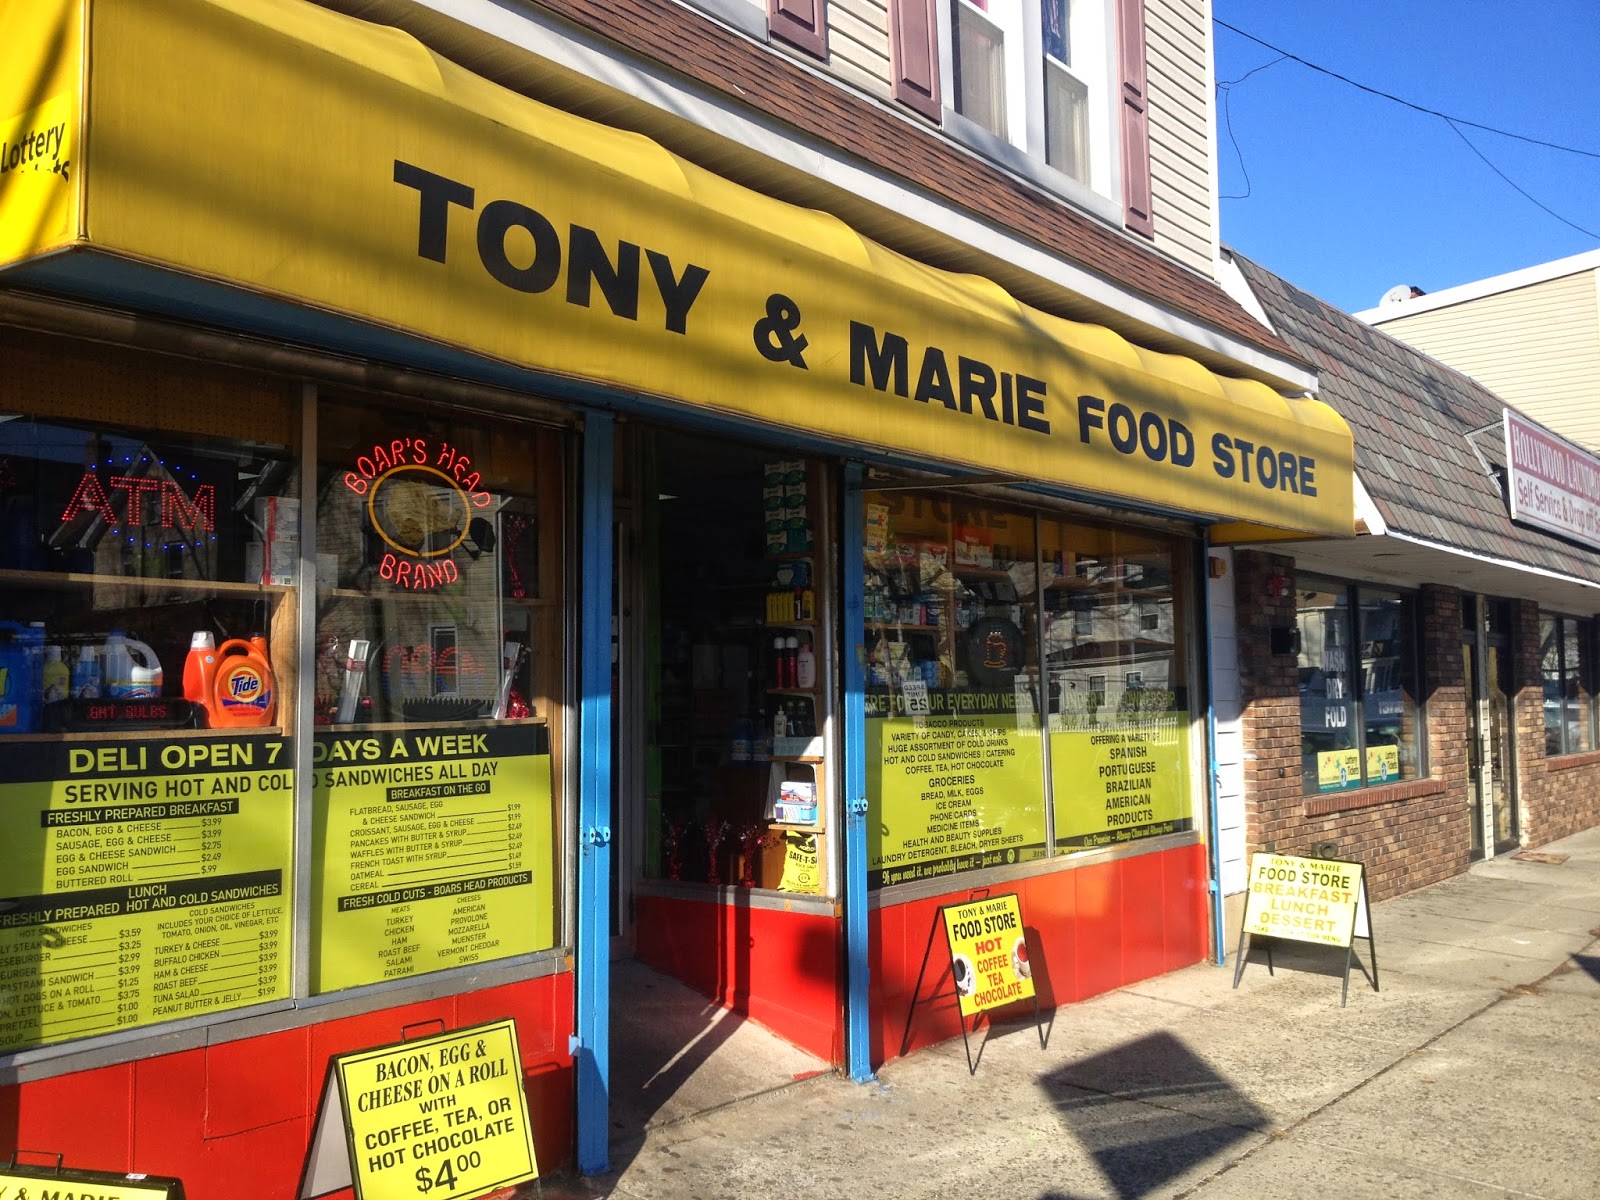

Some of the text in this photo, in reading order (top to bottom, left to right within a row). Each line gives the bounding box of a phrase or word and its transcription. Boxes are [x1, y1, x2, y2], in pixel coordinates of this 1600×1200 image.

[1, 122, 65, 173] Lottery
[393, 159, 1317, 497] TONY & MARIE FOOD STORE
[1512, 424, 1565, 485] HOLLYWOOD
[344, 438, 491, 508] BOAR'S HEAD
[61, 473, 215, 531] ATM
[1518, 477, 1533, 509] Self
[1534, 484, 1561, 520] Service
[379, 554, 458, 589] BRAND
[231, 675, 259, 696] Tide
[1326, 678, 1343, 699] DRY
[948, 694, 998, 710] EVERYDAY
[1325, 706, 1347, 728] FOLD
[313, 733, 489, 763] DAYS A WEEK
[1109, 746, 1147, 760] SPANISH
[69, 742, 283, 773] DELI OPEN 7
[325, 761, 498, 788] SANDWICHES ALL DAY
[1099, 761, 1156, 778] PORTUGUESE
[928, 774, 975, 787] GROCERIES
[1106, 778, 1151, 794] BRAZILIAN
[65, 781, 158, 804] SERVING
[165, 778, 205, 798] HOT
[211, 776, 251, 796] AND
[391, 782, 486, 800] BREAKFAST ON THE GO
[921, 787, 984, 800] BREAD, MILK, EGGS
[935, 799, 972, 810] ICE CREAM
[1105, 794, 1151, 811] AMERICAN
[47, 801, 234, 825] FRESHLY PREPARED BREAKFAST
[1107, 809, 1153, 827] PRODUCTS
[56, 818, 222, 839] BACON, EGG & CHEESE $3.99
[56, 830, 222, 851] SAUSAGE, EGG & CHEESE $3.99
[56, 841, 222, 864] EGG & CHEESE SANDWICH $2.75
[56, 853, 222, 876] EGG SANDWICH $2.49
[1310, 863, 1342, 873] MARIE
[56, 865, 217, 889] BUTTERED ROLL $.99
[351, 870, 384, 881] OATMEAL
[1259, 867, 1350, 889] FOOD STORE
[128, 884, 167, 899] LUNCH
[343, 874, 528, 909] FRESH COLD CUTS BOARS HEAD PRODUCTS
[351, 881, 379, 892] CEREAL
[1253, 882, 1352, 904] BREAKFAST
[55, 902, 120, 920] PREPARED
[126, 899, 150, 912] HOT
[152, 896, 176, 909] AND
[180, 892, 208, 906] COLD
[211, 883, 279, 902] SANDWICHES
[391, 905, 411, 914] MEATS
[453, 904, 486, 915] AMERICAN
[958, 901, 1007, 919] TONY & MARIE
[1271, 898, 1329, 916] LUNCH
[386, 915, 414, 926] TURKEY
[450, 913, 488, 926] PROVOLONE
[953, 912, 1016, 941] FOOD STORE
[1260, 912, 1336, 932] DESSERT
[384, 925, 414, 936] CHICKEN
[448, 922, 490, 936] MOZZARELLA
[154, 938, 220, 955] TURKEY & CHEESE
[391, 937, 408, 945] HAM
[451, 932, 487, 945] MUENSTER
[975, 937, 1002, 955] HOT
[154, 950, 220, 968] BUFFALO CHICKEN
[378, 943, 421, 959] ROAST BEEF
[458, 953, 479, 964] SWISS
[386, 956, 413, 967] SALAMI
[977, 954, 1009, 974] COFFEE
[153, 963, 209, 979] HAM & CHEESE
[384, 966, 414, 978] PATRAMI
[987, 972, 1004, 987] TEA
[153, 976, 198, 992] ROAST BEEF
[153, 988, 200, 1004] TUNA SALAD
[974, 981, 1022, 1007] CHOCOLATE
[152, 992, 241, 1016] PEANUT BUTTER & JELLY
[376, 1039, 487, 1083] BACON, EGG &
[357, 1058, 508, 1113] CHEESE ON A ROLL
[419, 1094, 457, 1114] WITH
[365, 1097, 512, 1150] COFFEE, TEA, OR
[368, 1117, 515, 1173] HOT CHOCOLATE
